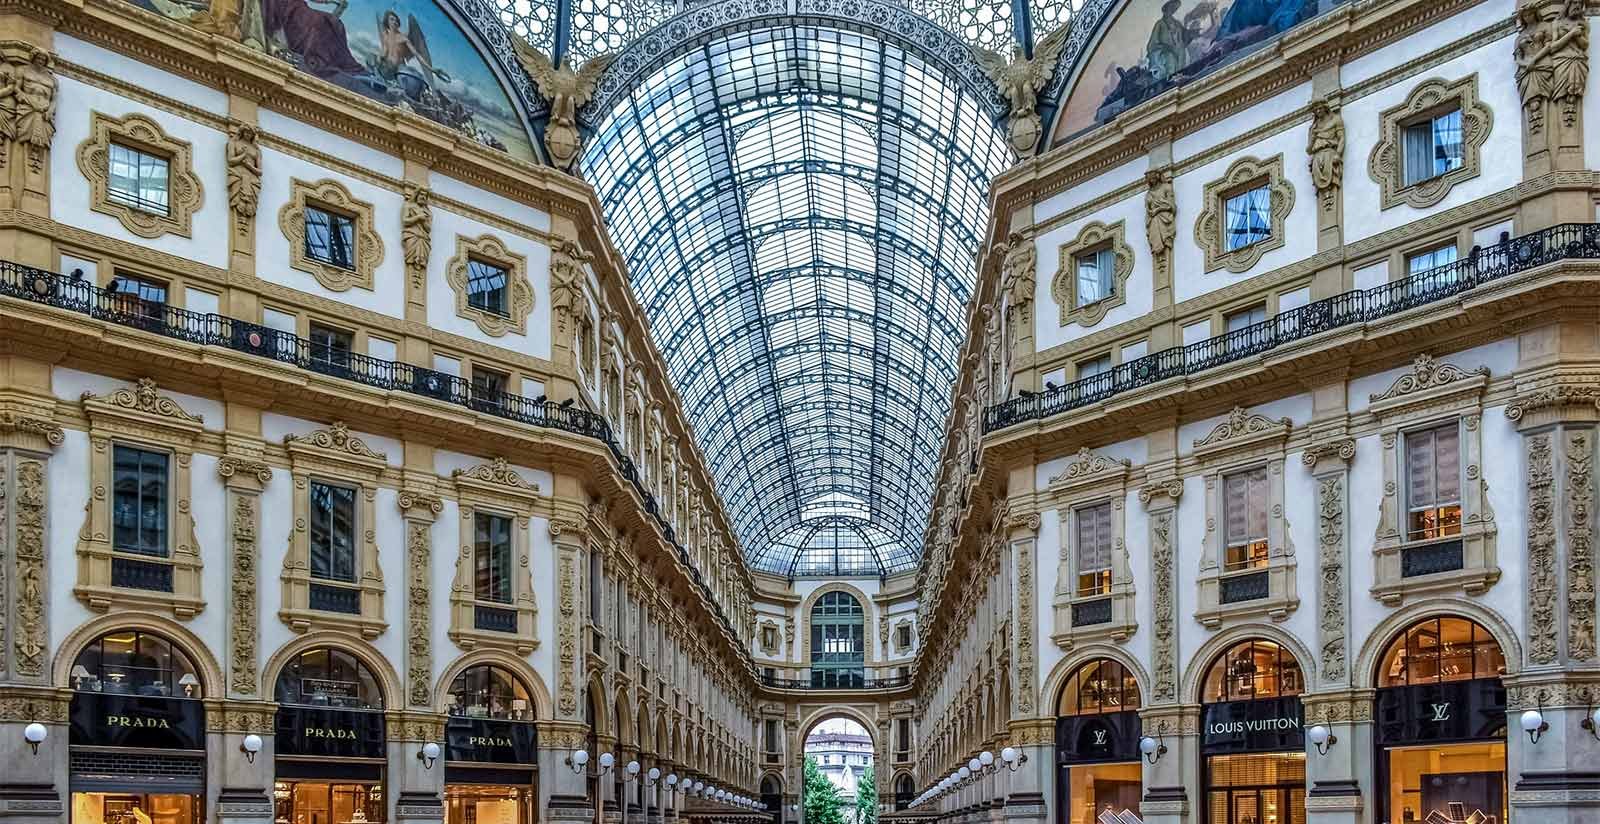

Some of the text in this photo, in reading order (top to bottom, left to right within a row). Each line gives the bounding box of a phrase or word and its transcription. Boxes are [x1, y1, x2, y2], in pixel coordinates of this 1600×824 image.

[107, 716, 169, 729] PRADA
[1210, 717, 1299, 734] LOUIS VUITTON
[305, 728, 357, 740] PRADA
[469, 736, 513, 747] PRADA
